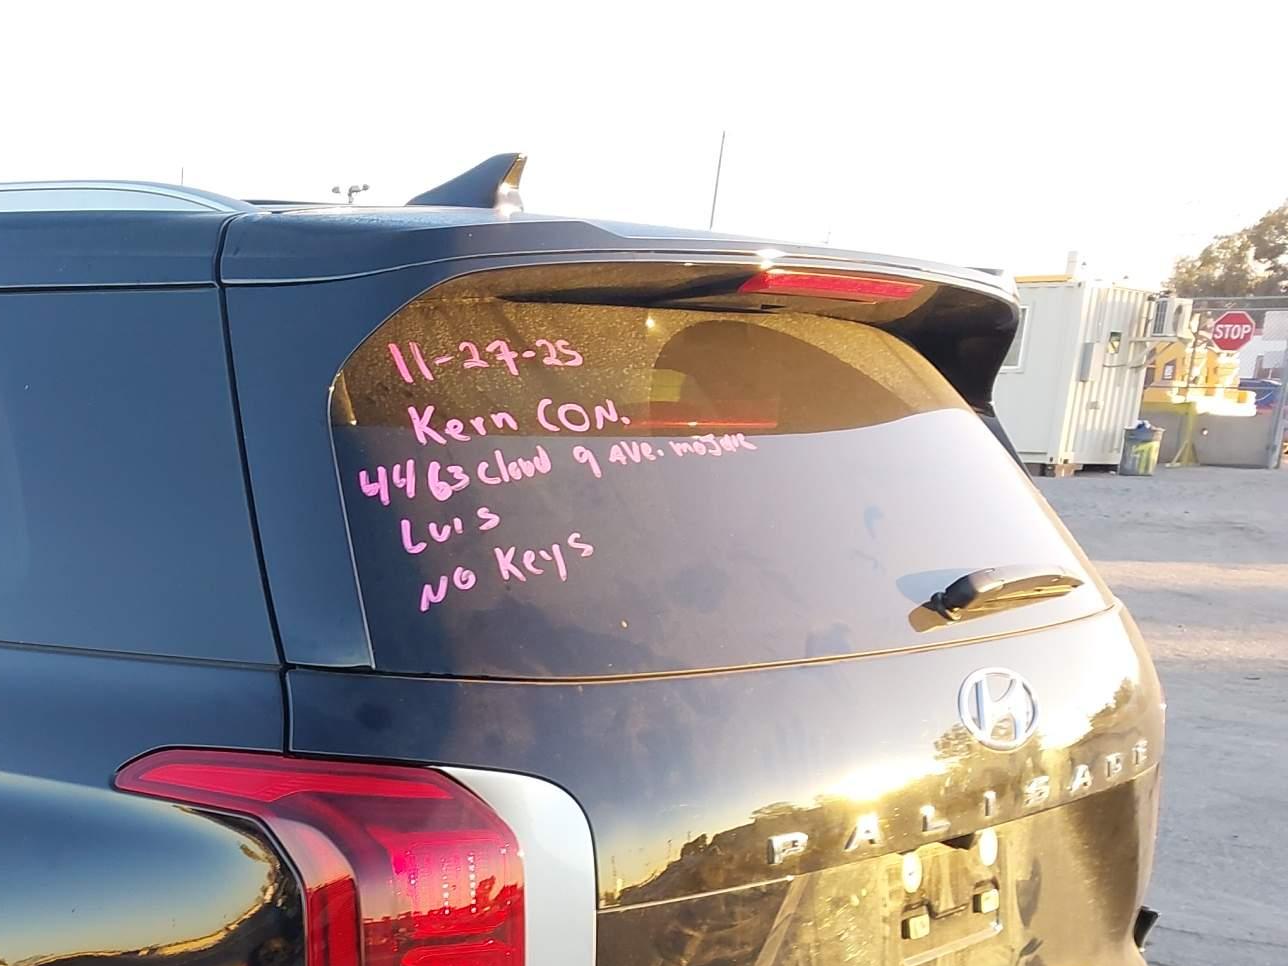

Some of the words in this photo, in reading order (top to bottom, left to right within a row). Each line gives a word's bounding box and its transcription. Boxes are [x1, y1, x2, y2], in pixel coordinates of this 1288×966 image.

[1213, 324, 1251, 340] STOP
[388, 339, 583, 384] 11-27-25
[767, 739, 1148, 865] PALISADE
